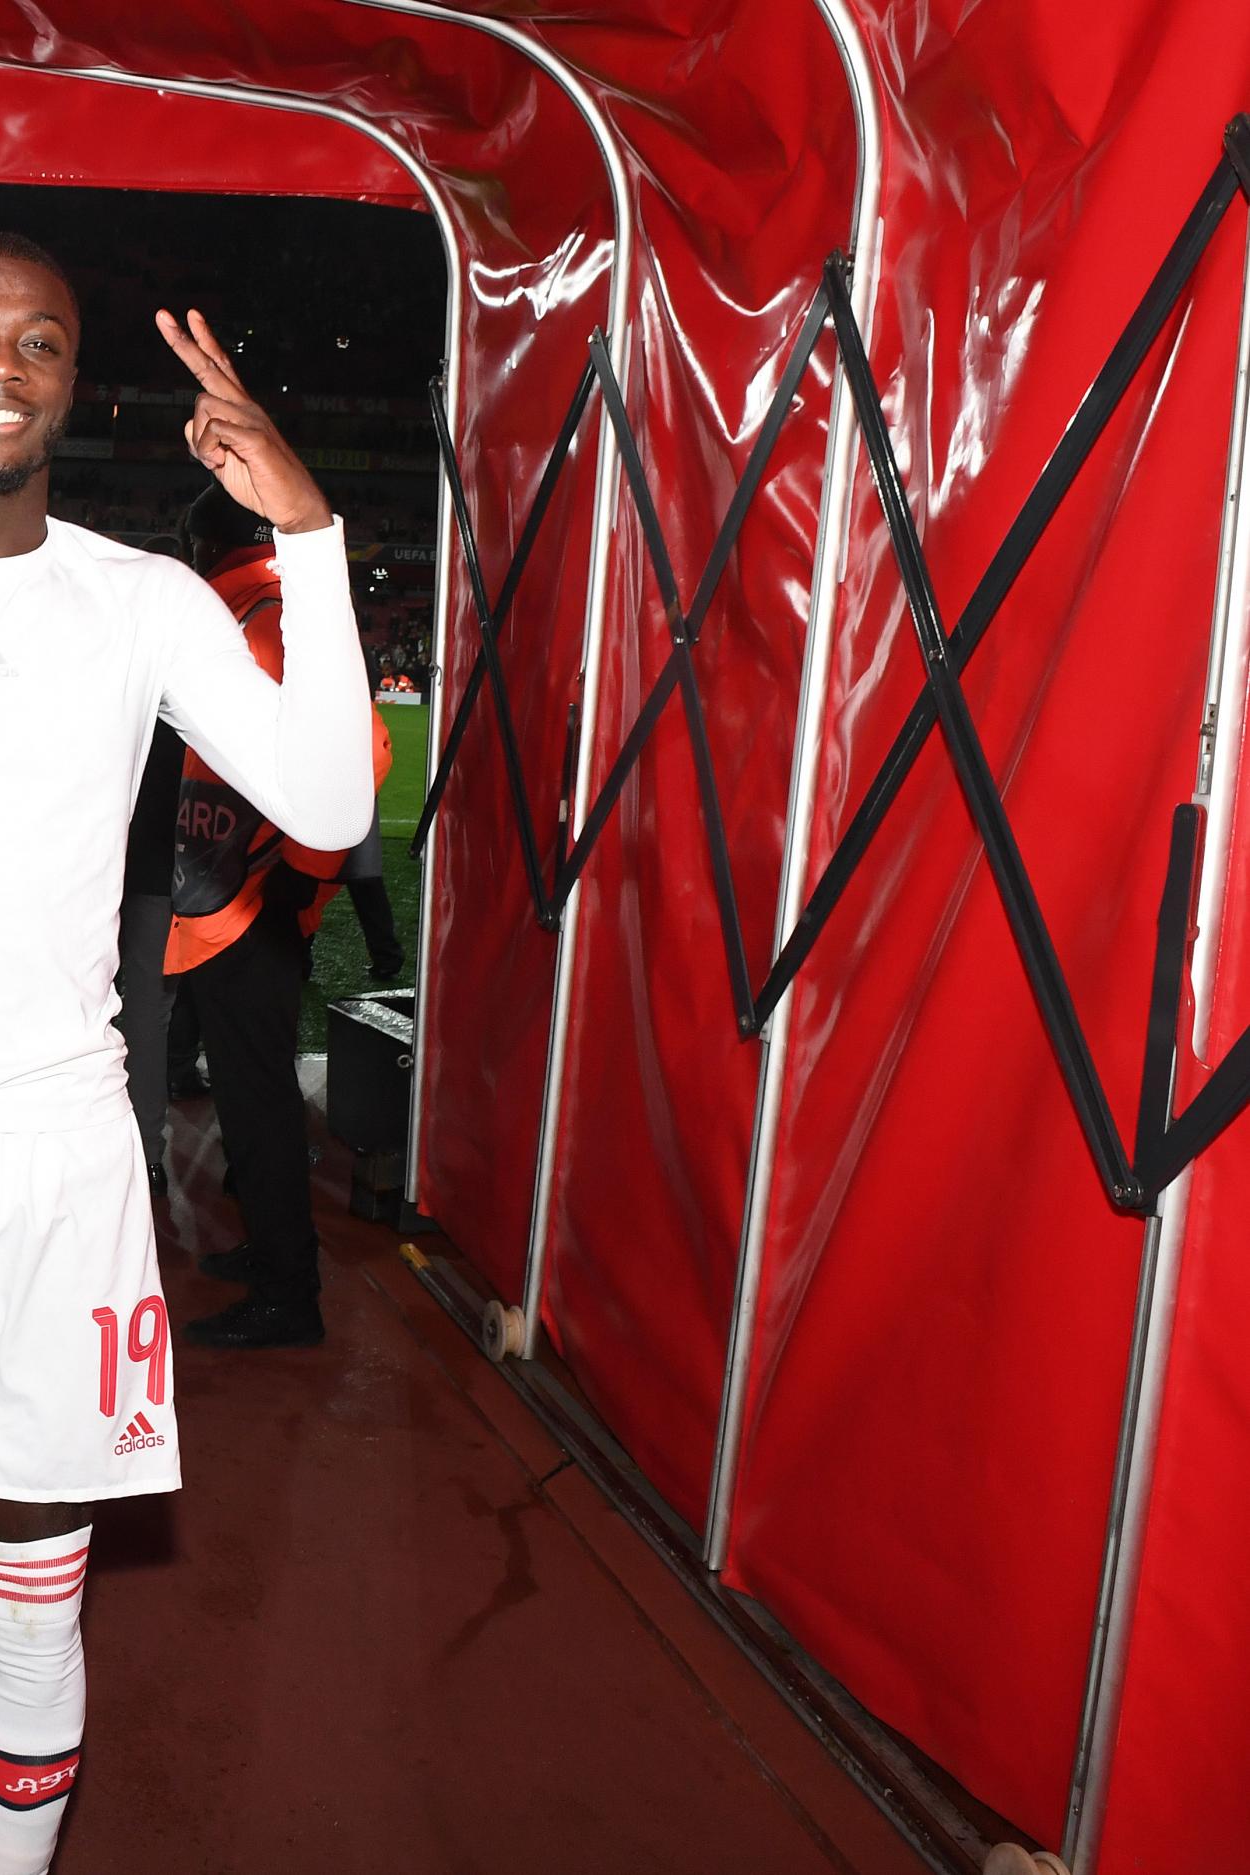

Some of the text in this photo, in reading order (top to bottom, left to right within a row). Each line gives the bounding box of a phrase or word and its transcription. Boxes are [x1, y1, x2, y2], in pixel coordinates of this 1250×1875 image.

[394, 549, 426, 560] UEFA
[92, 1295, 167, 1418] 19
[114, 1434, 165, 1456] adidas
